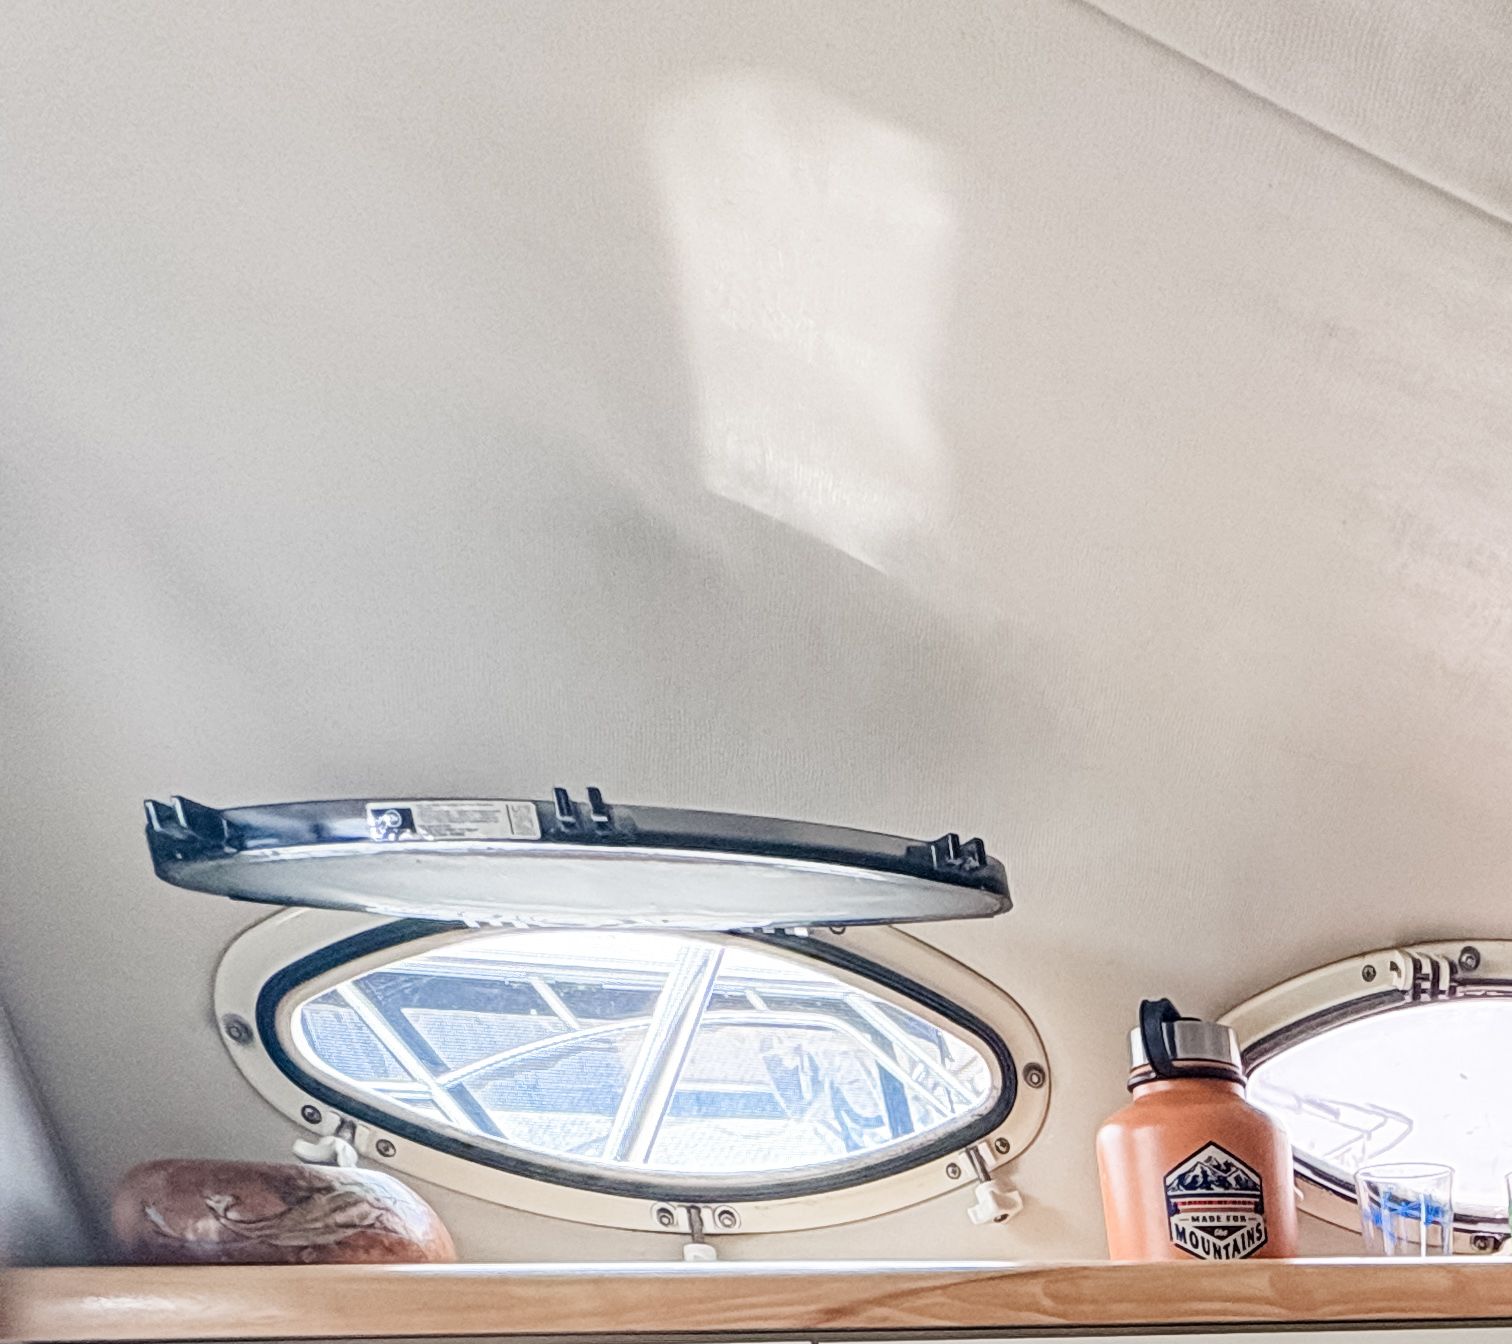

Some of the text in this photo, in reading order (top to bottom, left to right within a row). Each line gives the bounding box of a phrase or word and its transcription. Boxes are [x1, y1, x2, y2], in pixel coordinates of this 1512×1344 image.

[1191, 1215, 1247, 1223] MADE FOR
[1174, 1222, 1263, 1260] MOUNTAINS
